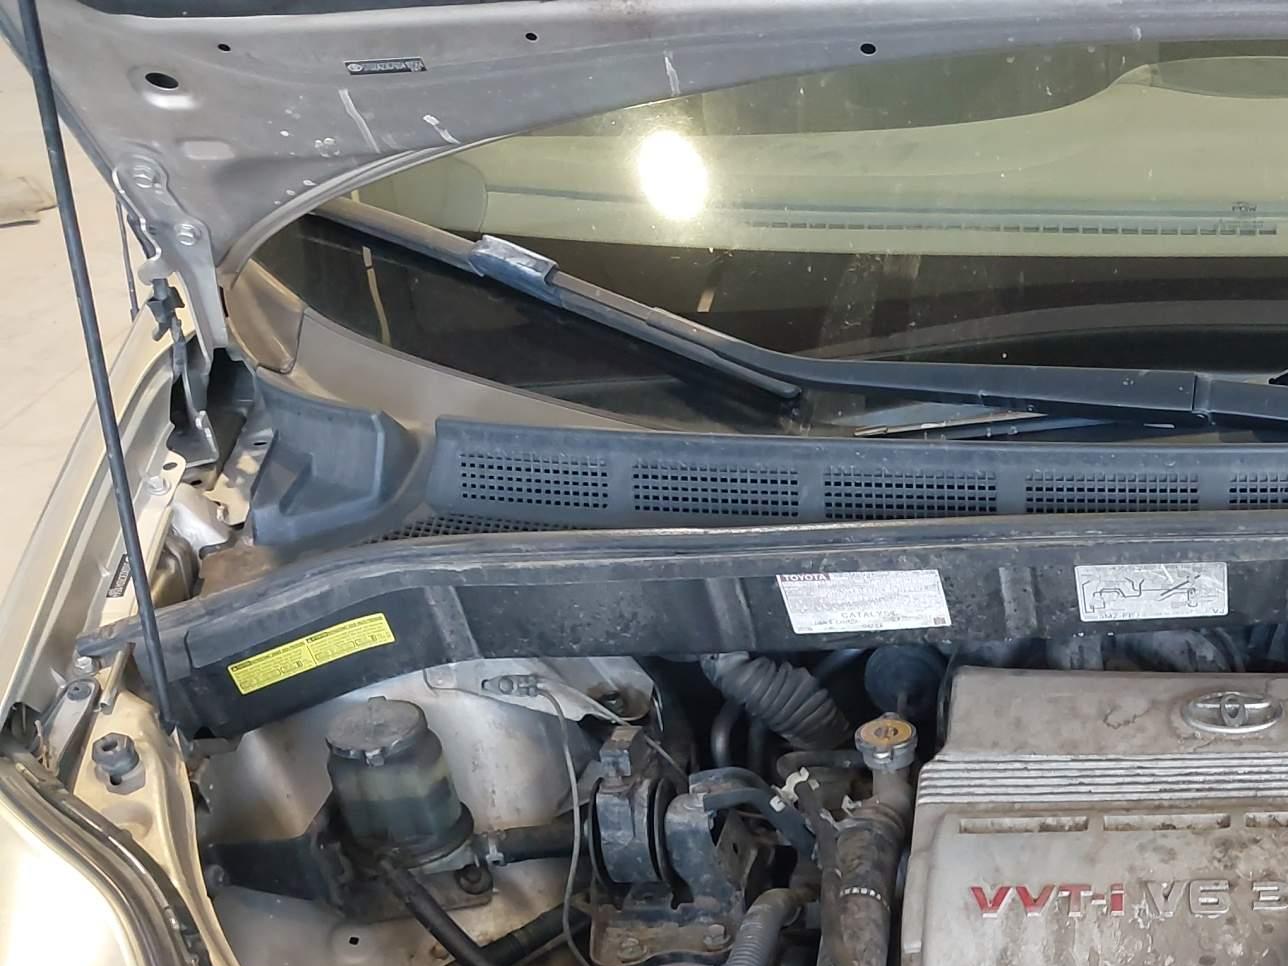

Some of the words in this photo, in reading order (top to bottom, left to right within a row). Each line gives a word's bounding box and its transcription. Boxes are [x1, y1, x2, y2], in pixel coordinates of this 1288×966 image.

[783, 574, 827, 582] TOYOTA
[970, 883, 1126, 919] VVT-i
[1145, 879, 1231, 919] V6
